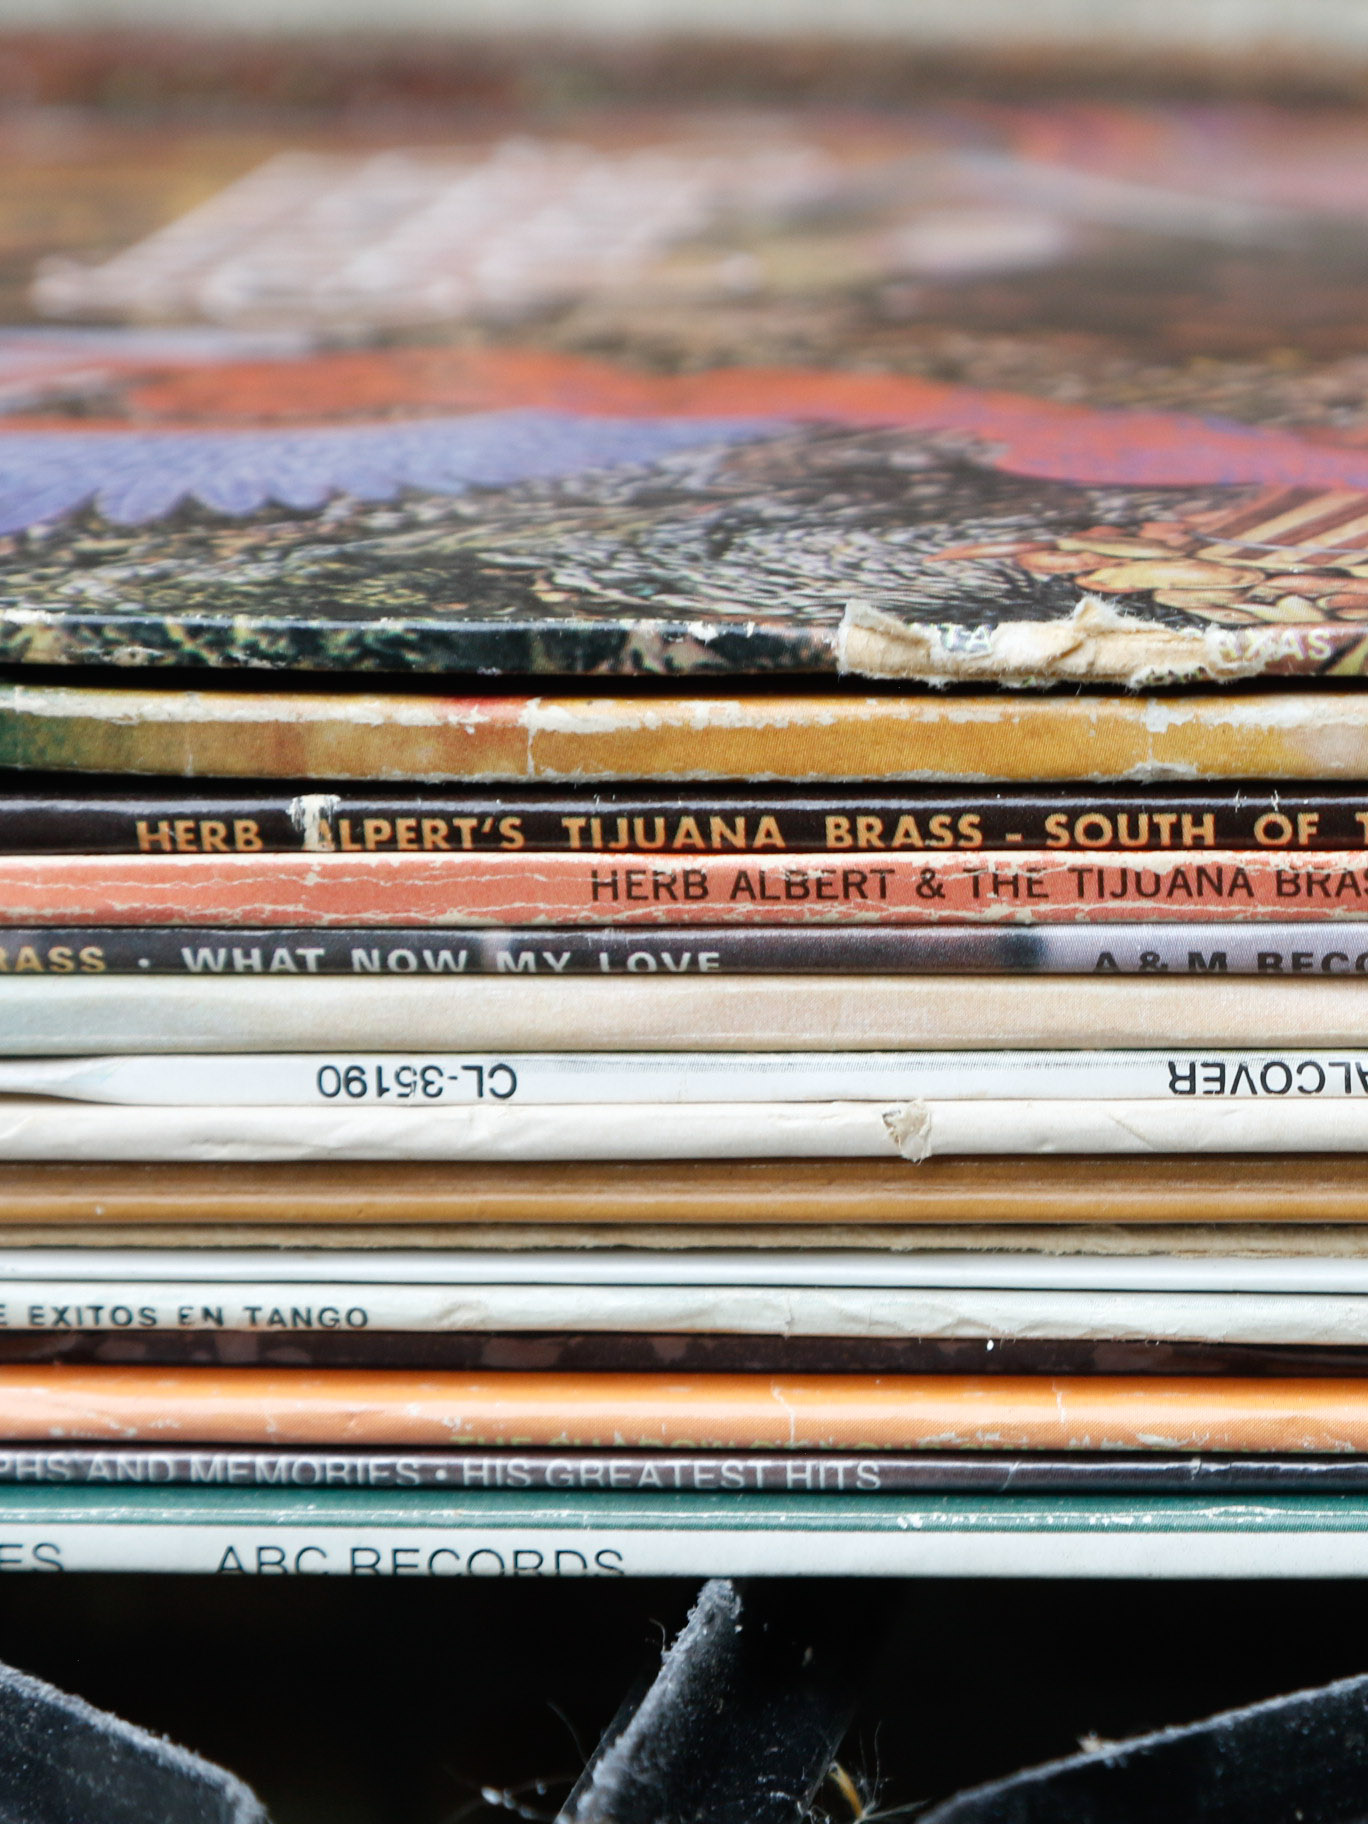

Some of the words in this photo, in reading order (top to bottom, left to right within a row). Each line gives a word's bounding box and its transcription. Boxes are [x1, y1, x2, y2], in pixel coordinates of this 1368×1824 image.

[136, 819, 263, 851] HERB
[561, 815, 786, 849] TIJUANA
[826, 813, 982, 849] BRASS
[1045, 812, 1216, 848] SOUTH
[1253, 812, 1319, 846] OF
[591, 869, 709, 900] HERB
[730, 868, 895, 900] ALBERT
[915, 868, 946, 899] &
[962, 867, 1049, 898] THE
[1069, 867, 1254, 898] TIJUANA
[181, 947, 326, 973] WHAT
[351, 948, 467, 973] NOW
[496, 951, 571, 973] MY
[600, 951, 720, 973] LOVE
[1093, 951, 1122, 973] A
[1188, 951, 1228, 973] M
[318, 1064, 518, 1098] CL-35190
[28, 1305, 157, 1327] EXITOS
[177, 1305, 224, 1327] EN
[243, 1306, 369, 1328] TANGO
[87, 1453, 176, 1482] AND
[190, 1454, 421, 1486] MEMORIES
[463, 1457, 532, 1487] HIS
[545, 1458, 768, 1488] GREATEST
[786, 1459, 882, 1490] HITS
[216, 1545, 328, 1575] ABC
[350, 1547, 624, 1576] RECORDS
